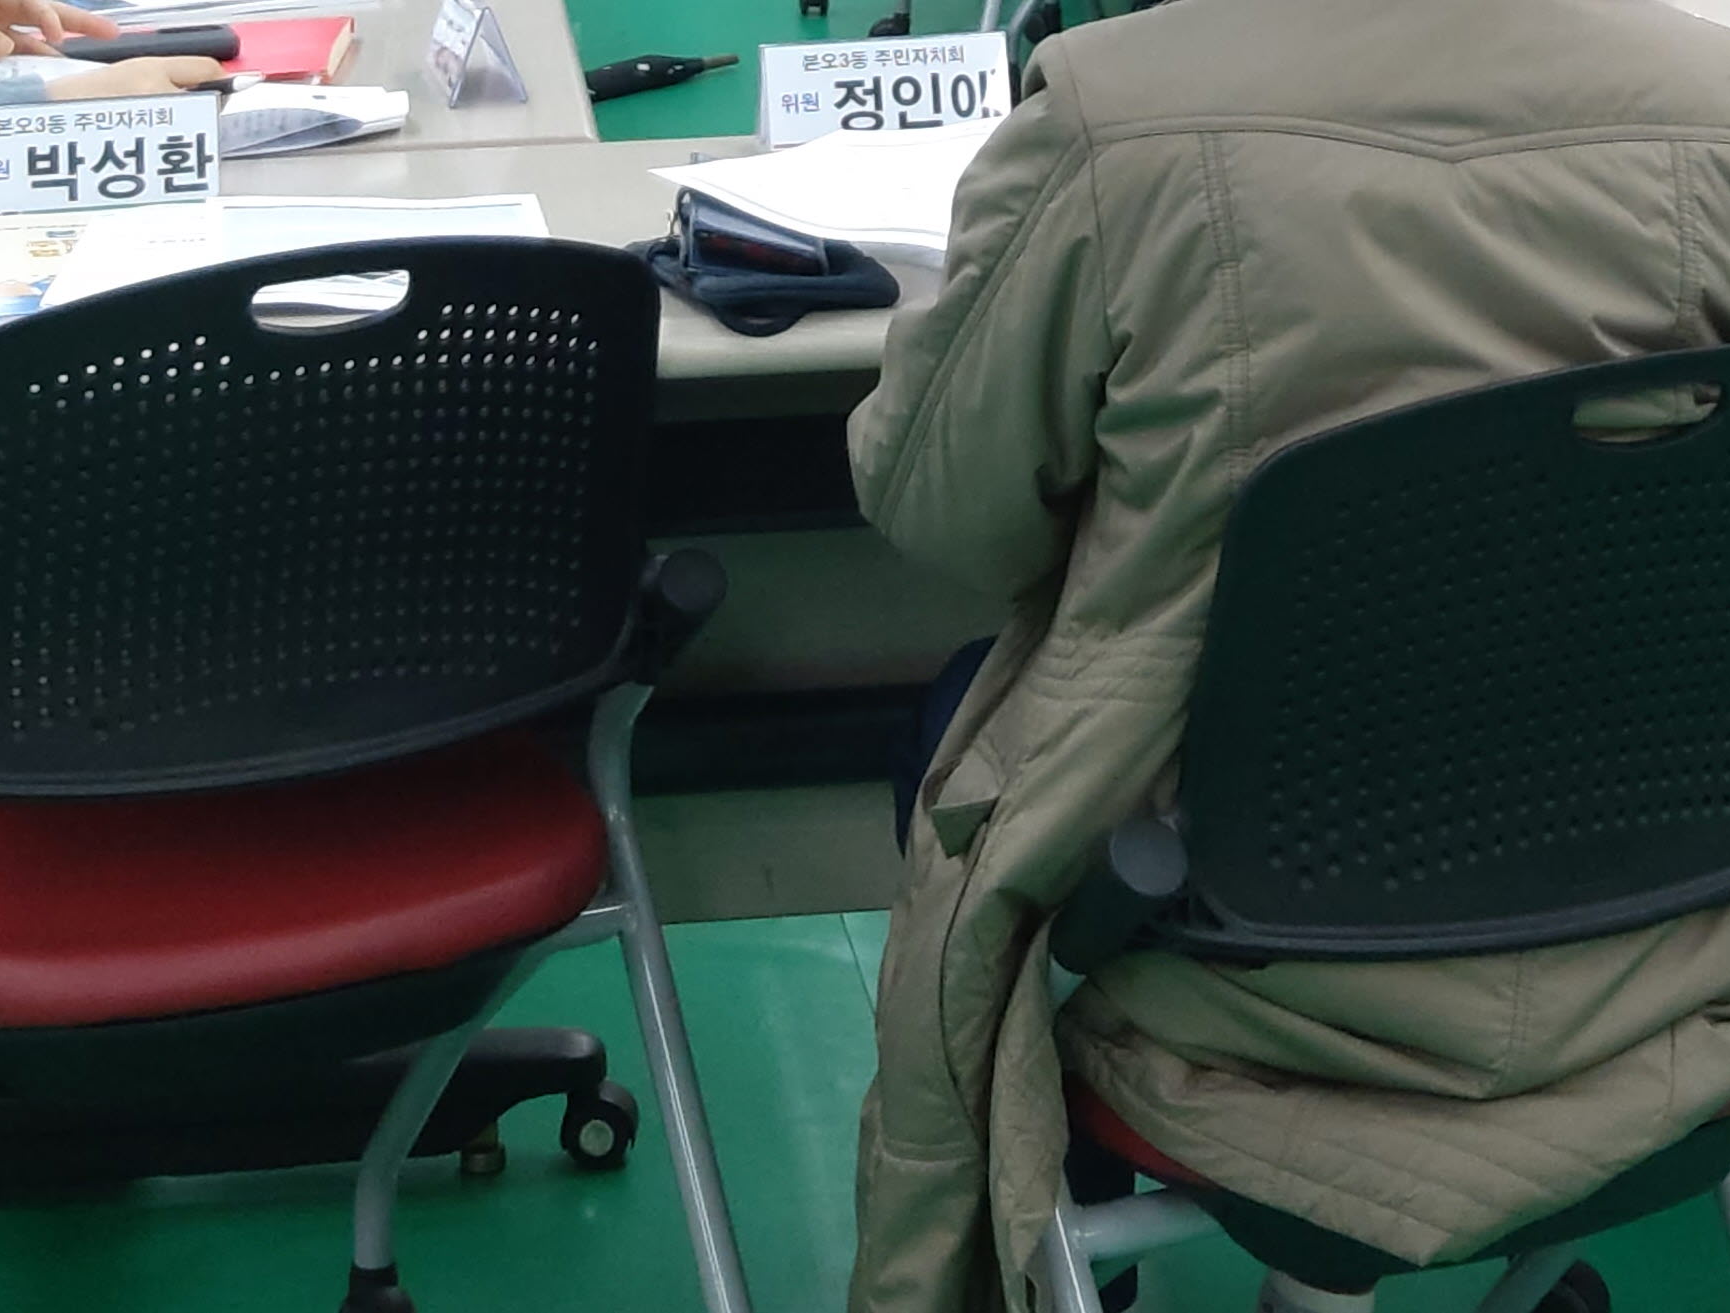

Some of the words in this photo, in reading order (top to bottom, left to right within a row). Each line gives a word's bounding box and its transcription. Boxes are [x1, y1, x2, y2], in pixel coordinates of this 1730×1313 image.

[874, 46, 965, 67] 주민자치회
[781, 91, 820, 114] 위원
[74, 108, 174, 131] 주민자치회
[27, 132, 215, 202] 박성환
